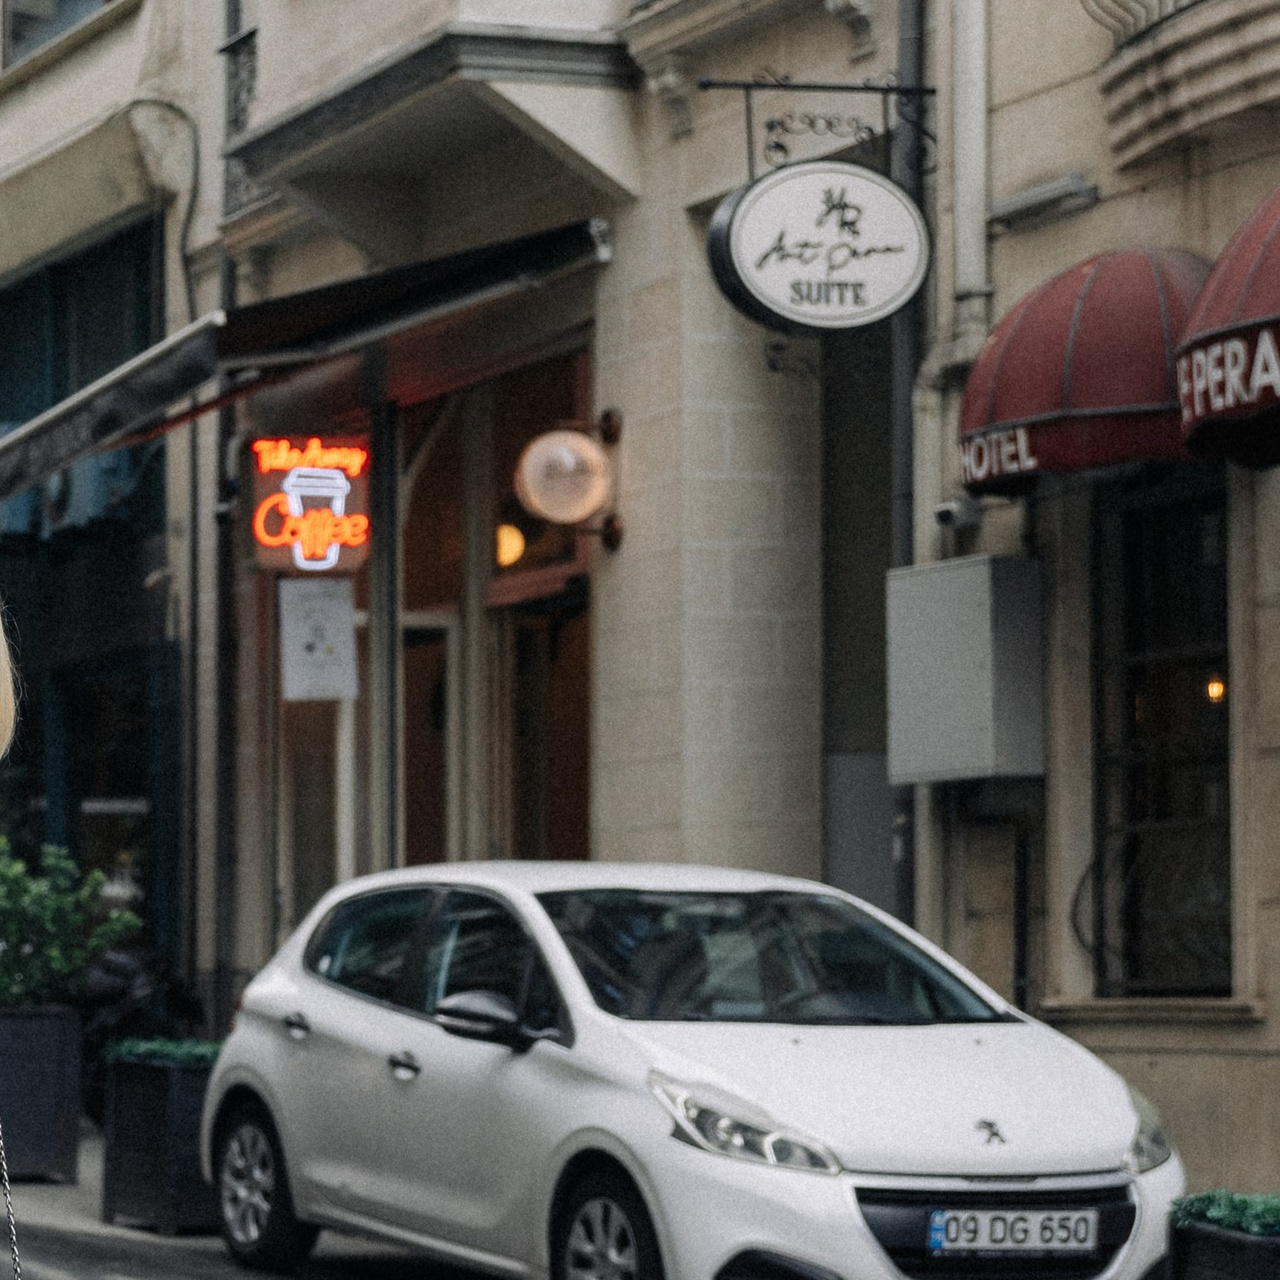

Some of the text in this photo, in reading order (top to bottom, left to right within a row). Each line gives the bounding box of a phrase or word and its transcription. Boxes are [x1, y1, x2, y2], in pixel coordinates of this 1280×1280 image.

[790, 282, 866, 306] SUITE
[1192, 329, 1280, 418] PERA
[961, 426, 1037, 484] HOTEL
[253, 493, 369, 558] Coffee
[946, 1216, 1089, 1244] 09 DG 650
